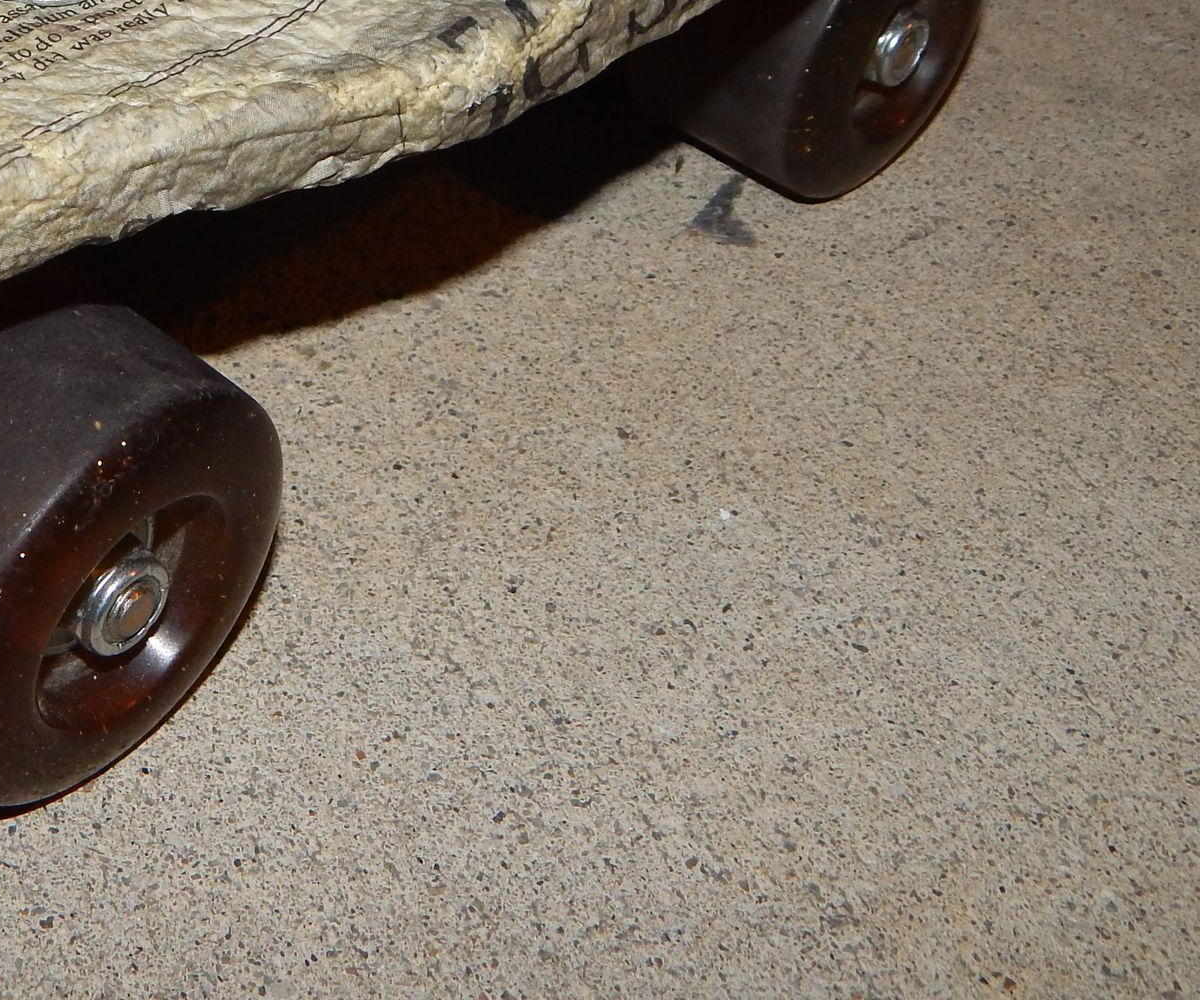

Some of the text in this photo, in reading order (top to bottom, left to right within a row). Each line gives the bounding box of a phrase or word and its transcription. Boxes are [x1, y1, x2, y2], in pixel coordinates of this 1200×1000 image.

[7, 48, 32, 62] to
[35, 31, 63, 54] do
[66, 24, 82, 33] a
[33, 51, 68, 72] did
[70, 30, 113, 52] was
[116, 2, 170, 33] really
